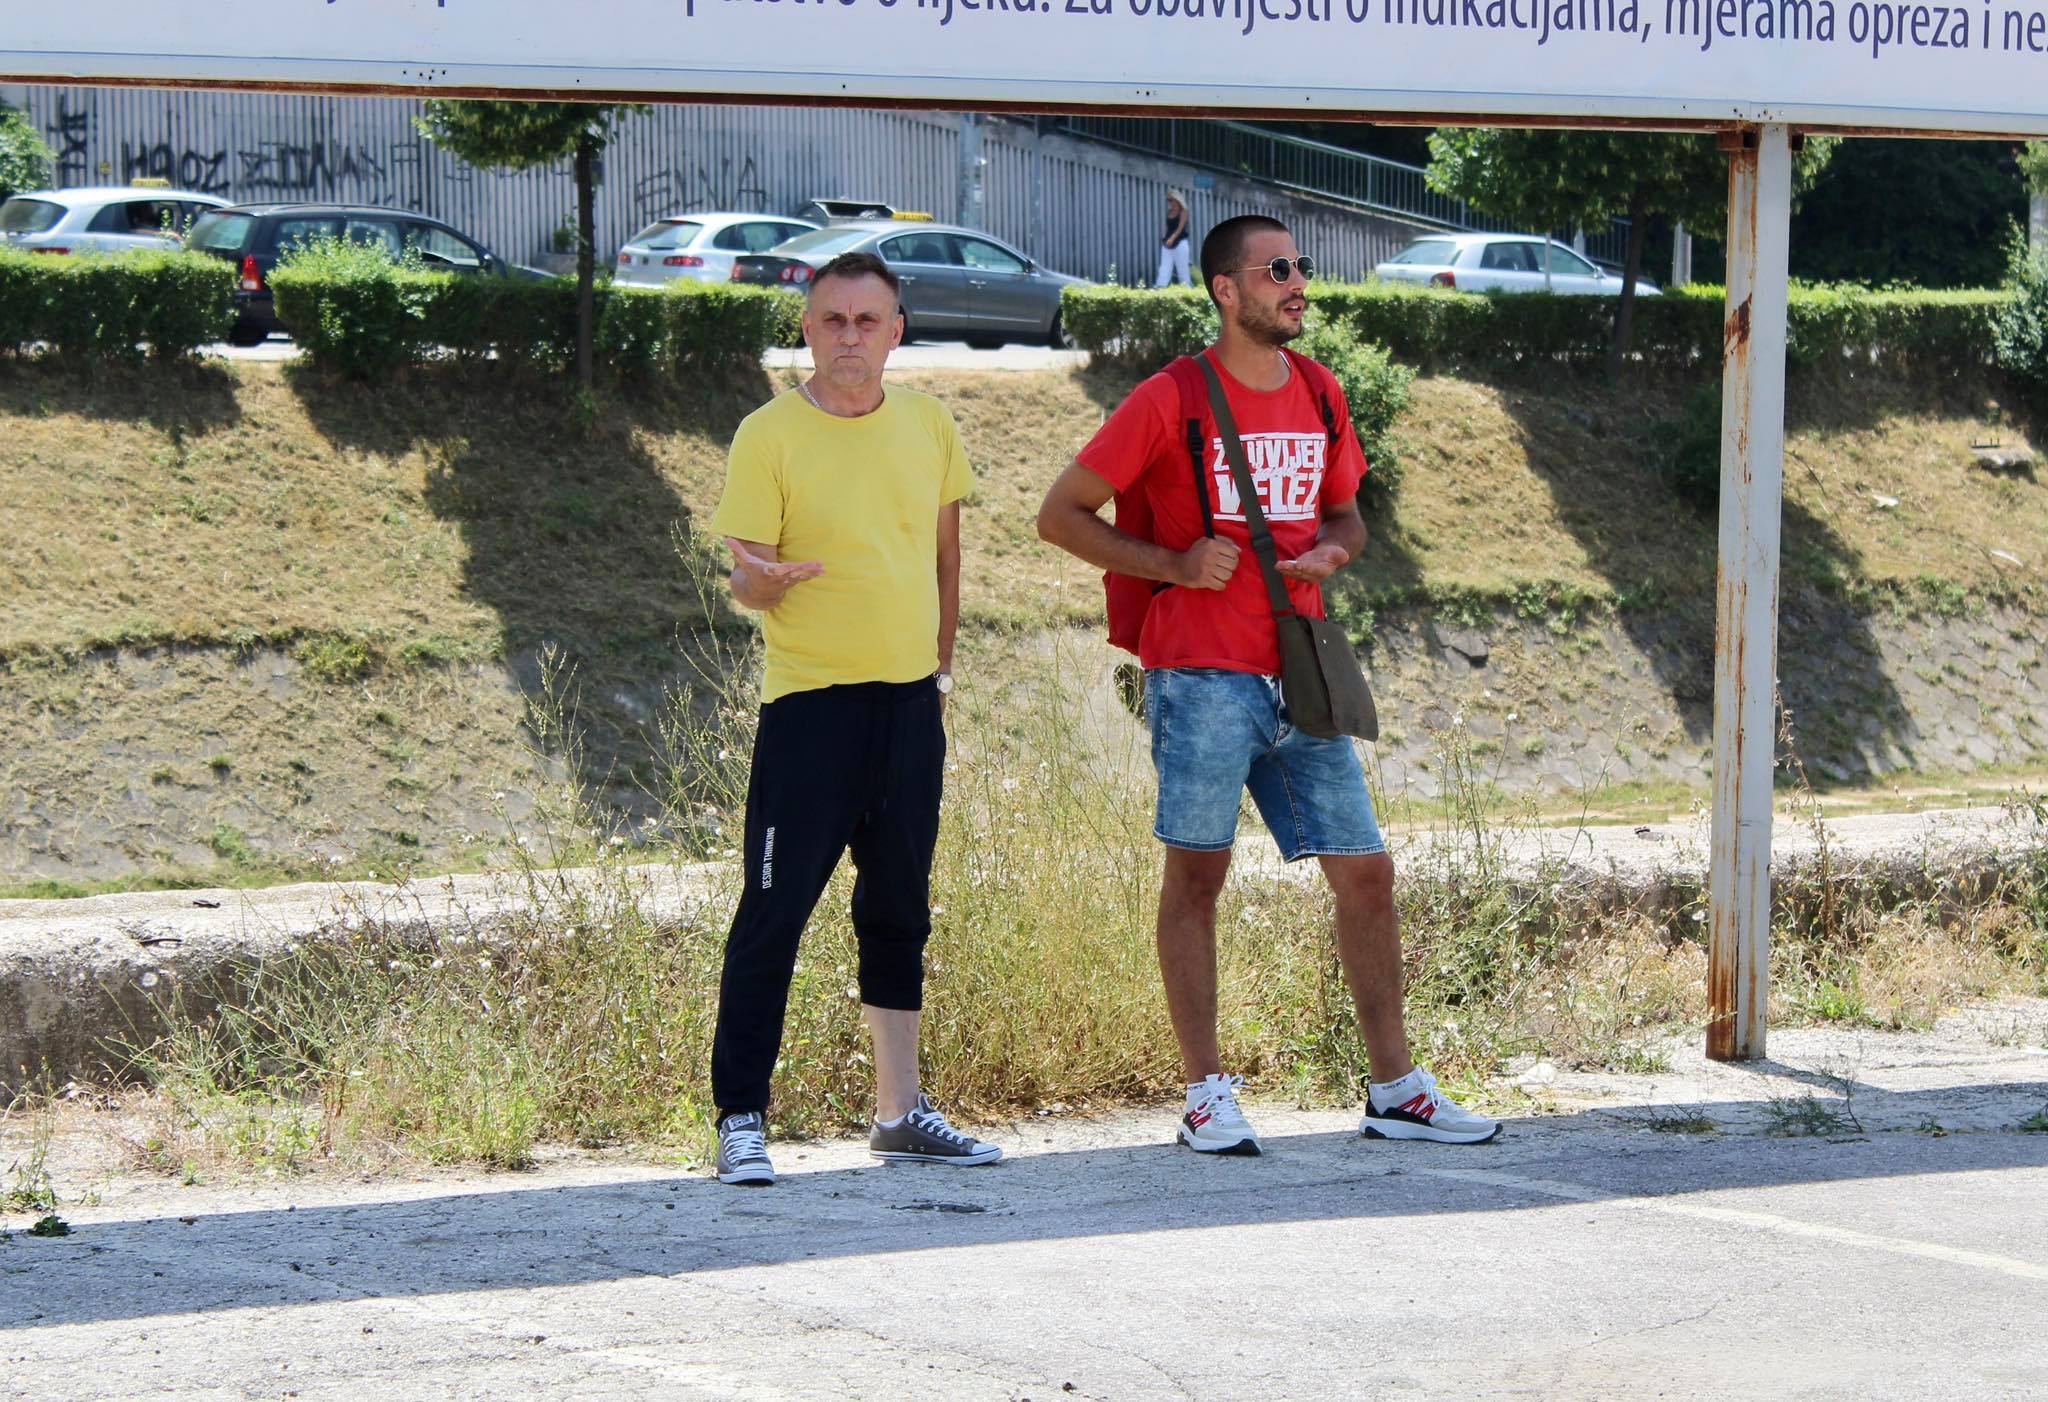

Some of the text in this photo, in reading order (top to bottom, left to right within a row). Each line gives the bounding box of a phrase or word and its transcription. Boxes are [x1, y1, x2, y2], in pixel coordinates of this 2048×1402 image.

[1665, 0, 1835, 51] mjerama
[1848, 2, 1969, 59] opreza
[1983, 0, 1990, 49] i
[2003, 9, 2048, 53] ne
[1213, 439, 1326, 472] ZUVIJEK
[762, 827, 776, 889] DESIGN THINKING
